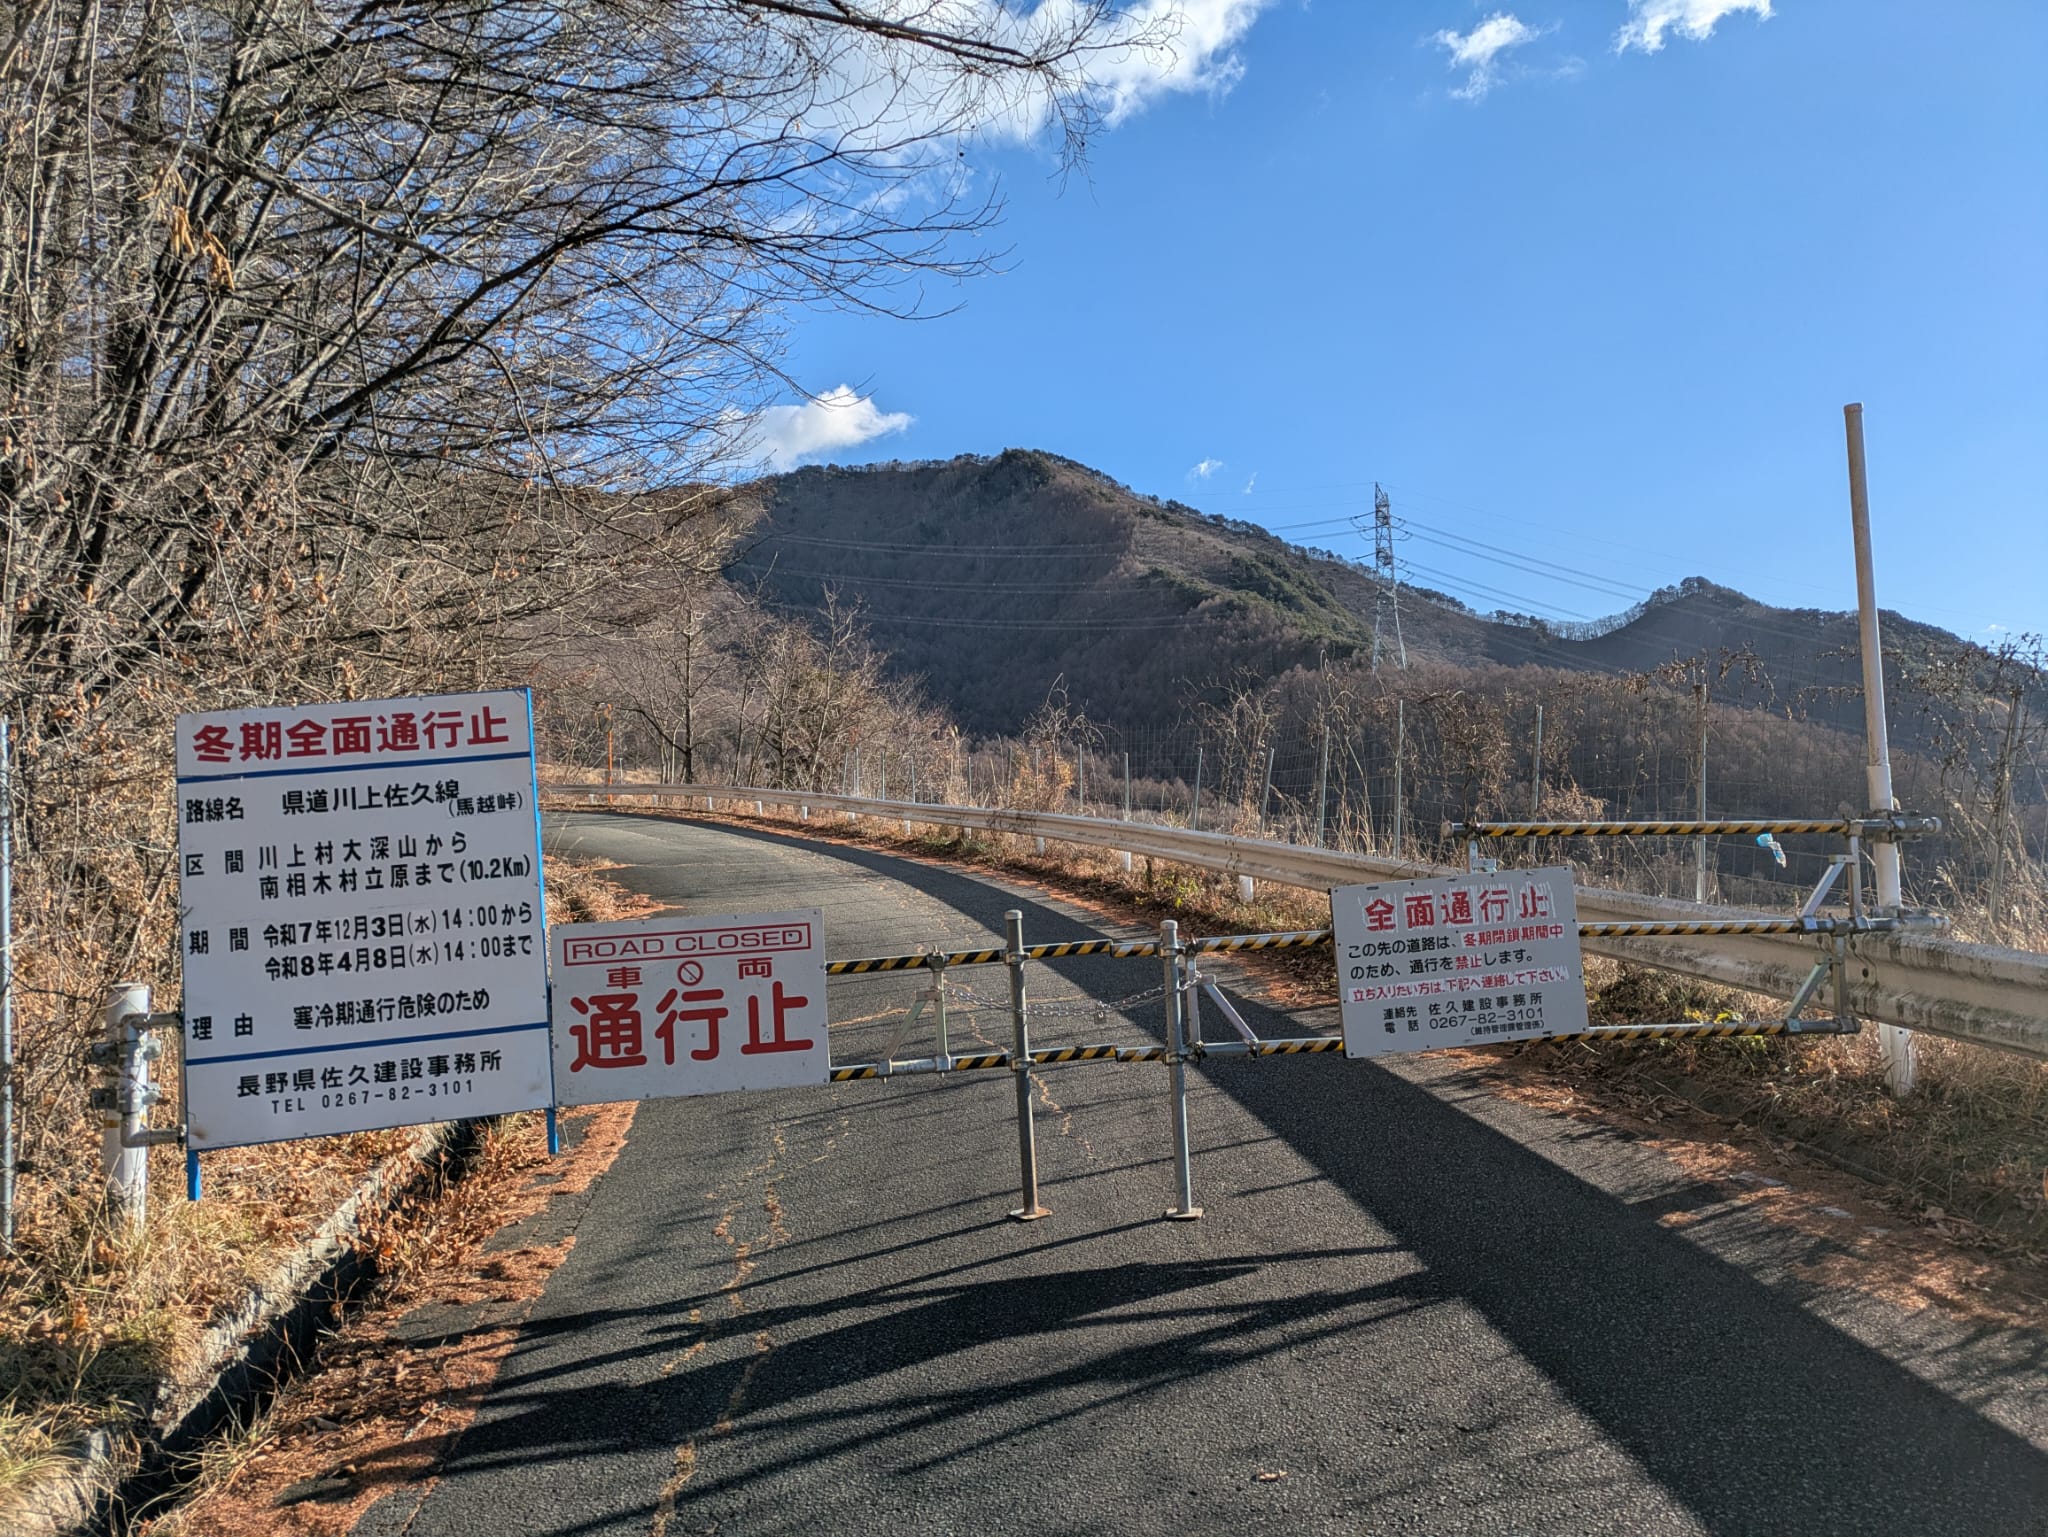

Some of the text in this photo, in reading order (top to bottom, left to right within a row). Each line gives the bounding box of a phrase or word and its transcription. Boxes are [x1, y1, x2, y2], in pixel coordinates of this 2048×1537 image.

[192, 706, 509, 763] 冬期全面通行止
[185, 779, 523, 824] 路線名 県道川上佐久線 (馬越峠)
[258, 831, 468, 871] 川上村大深山から
[260, 854, 532, 901] 南相木村立原まで(10.2Km)
[263, 901, 533, 950] 令和7年12月3日(水)14:00から
[1365, 886, 1549, 932] 全面通行止
[264, 934, 533, 982] 令和8年4月8日(水)14:00まで
[572, 929, 802, 960] ROAD CLOSED
[293, 988, 490, 1031] 寒冷期通行危険のため
[569, 980, 814, 1073] 通行止
[1383, 992, 1543, 1020] 連絡先 佐久建設事務所
[1429, 1007, 1544, 1030] 0267-82-3101
[237, 1050, 503, 1098] 長野県佐久建設事務所
[272, 1080, 474, 1114] TEL 0267-82-3101
